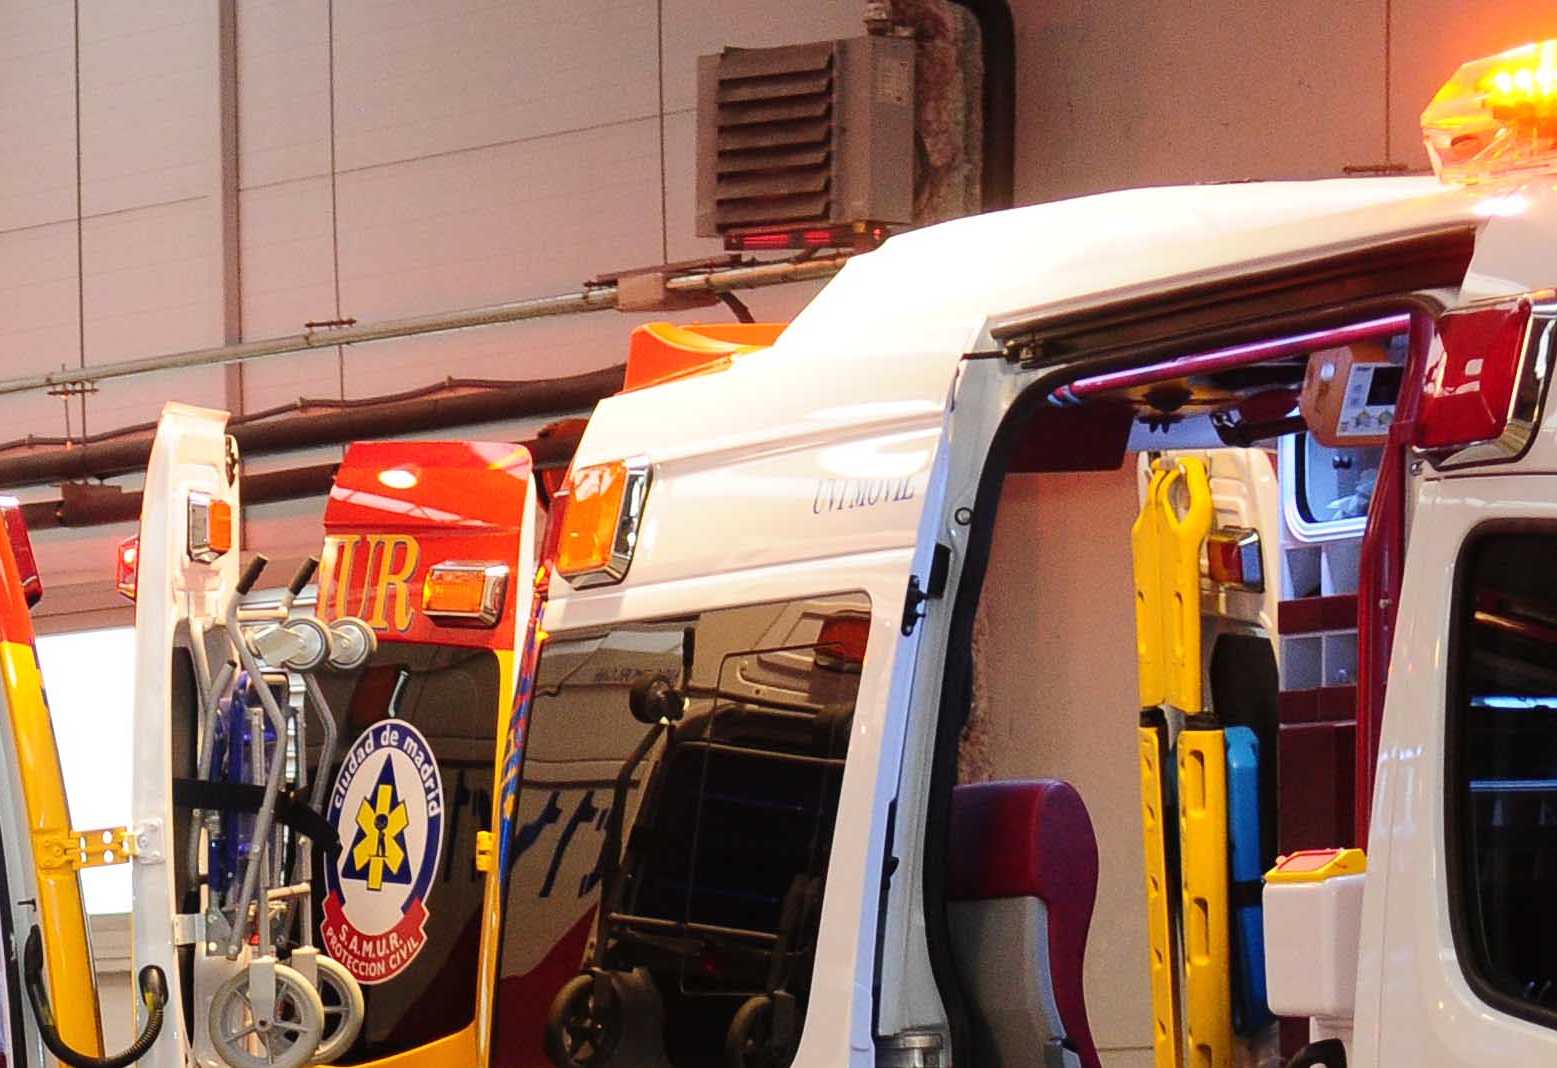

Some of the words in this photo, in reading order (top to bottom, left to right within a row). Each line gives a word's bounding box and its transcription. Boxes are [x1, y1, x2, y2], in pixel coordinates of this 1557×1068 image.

[333, 730, 375, 810] ciudad
[380, 724, 400, 747] de
[403, 735, 441, 818] madrid
[325, 926, 386, 977] PROTECCION
[389, 936, 419, 970] CIVIL
[339, 923, 404, 958] S.A.M.U.R.
